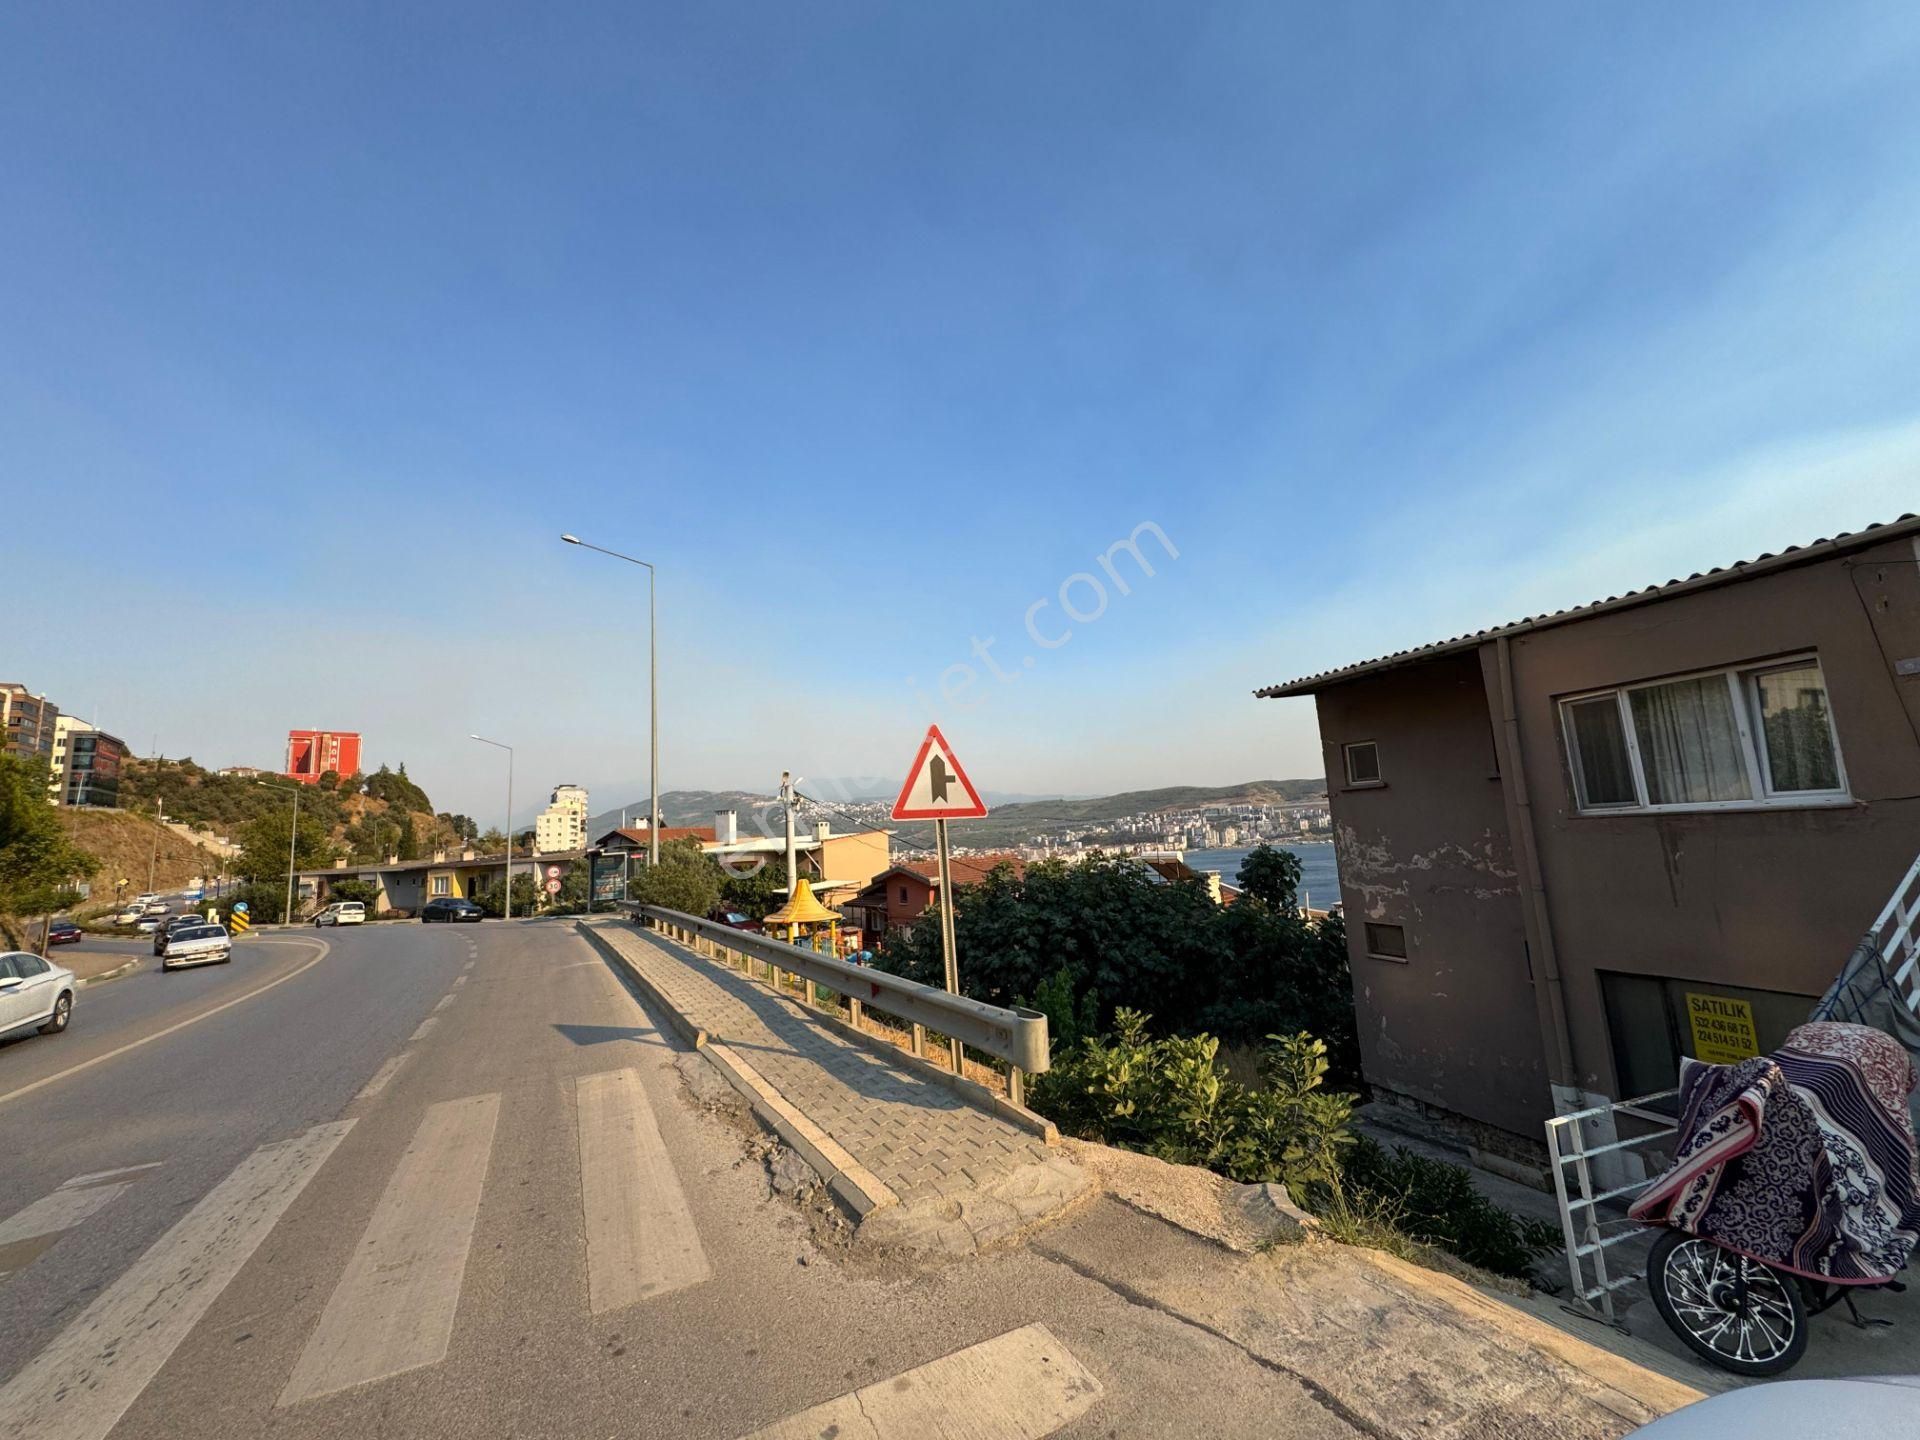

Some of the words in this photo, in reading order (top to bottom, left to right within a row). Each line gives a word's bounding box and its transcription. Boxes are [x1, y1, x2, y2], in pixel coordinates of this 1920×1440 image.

[1691, 998, 1747, 1019] SATILIK
[1738, 1023, 1750, 1036] 73
[1697, 1030, 1713, 1042] 224
[1713, 1032, 1729, 1046] 514
